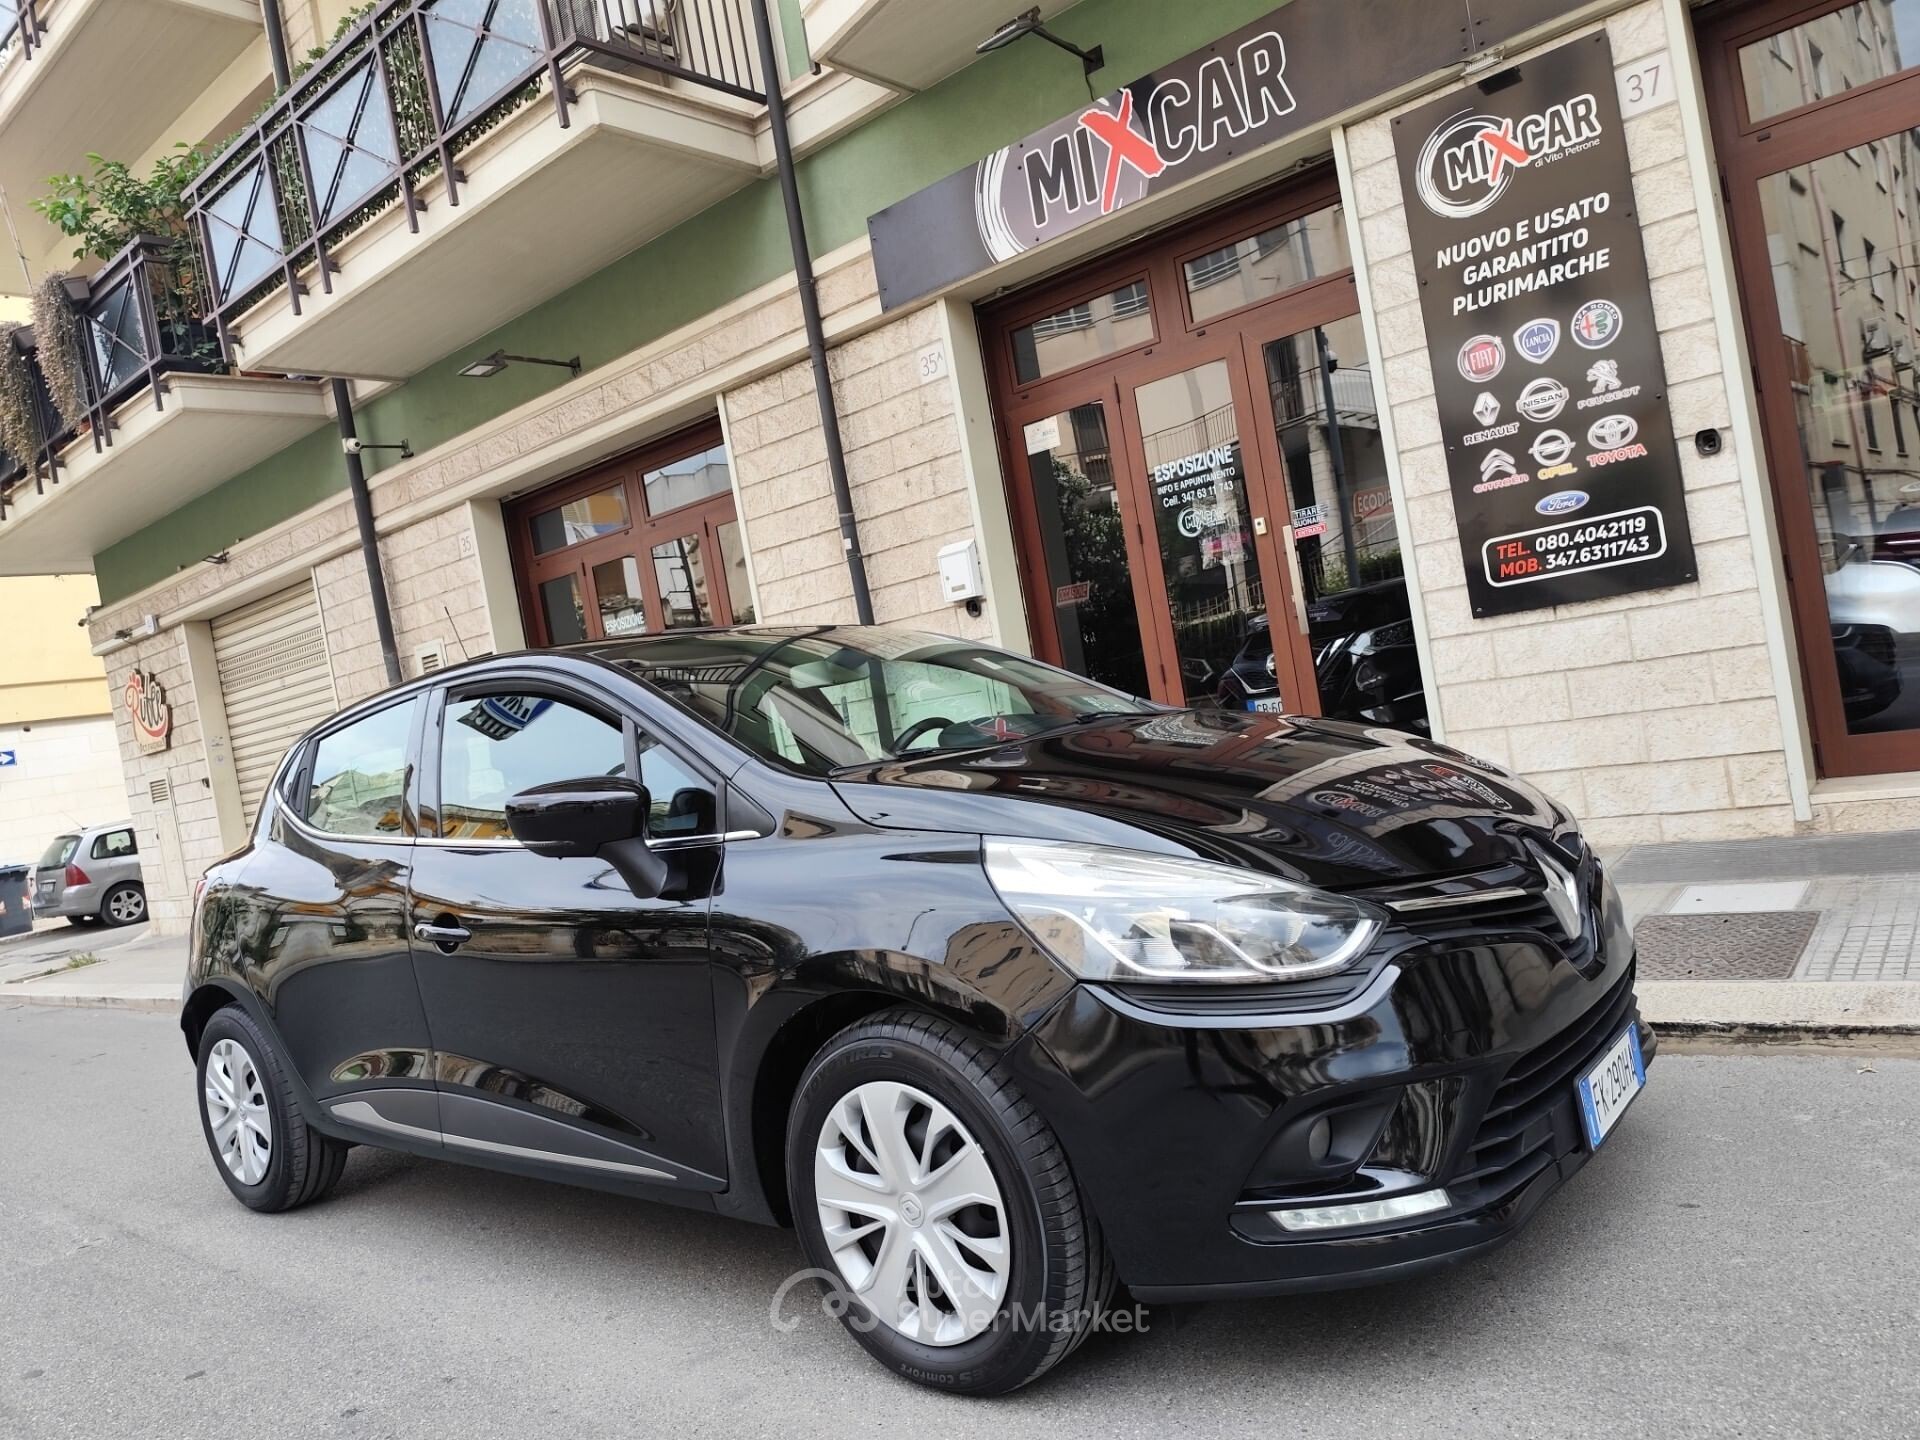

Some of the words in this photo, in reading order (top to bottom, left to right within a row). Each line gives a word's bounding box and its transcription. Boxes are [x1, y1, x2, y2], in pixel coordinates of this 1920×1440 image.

[1626, 65, 1660, 103] 37
[1023, 31, 1296, 229] MIXCAR
[1444, 94, 1602, 191] MIXCAR
[1544, 151, 1564, 164] Vito
[1565, 138, 1601, 157] Petrone
[1436, 227, 1510, 269] NUOVO
[1515, 219, 1530, 242] E
[1533, 192, 1610, 234] USATO
[1462, 227, 1589, 286] GARANTITO
[1452, 247, 1610, 316] PLURIMARCHE
[1525, 332, 1551, 348] LANCIA
[1469, 346, 1494, 371] FIAT
[1522, 391, 1563, 408] NISSAN
[1463, 421, 1520, 446] RENAULT
[1153, 444, 1234, 483] ESPOSIZIONE
[1586, 443, 1648, 468] TOYOTA
[1157, 483, 1174, 496] INFO
[1174, 482, 1179, 491] E
[1180, 466, 1235, 490] APPUNTAMENTO
[1537, 462, 1578, 481] OPEL
[1162, 494, 1181, 508] Cell.
[1181, 490, 1195, 503] 347
[1196, 488, 1207, 499] 63
[1547, 494, 1577, 511] Ford
[1496, 541, 1530, 560] TEL.
[1535, 516, 1646, 552] 080.4042119
[1500, 558, 1542, 578] MOB.
[1545, 535, 1650, 570] 347.6311743
[605, 611, 645, 633] ESPOSIZIONE
